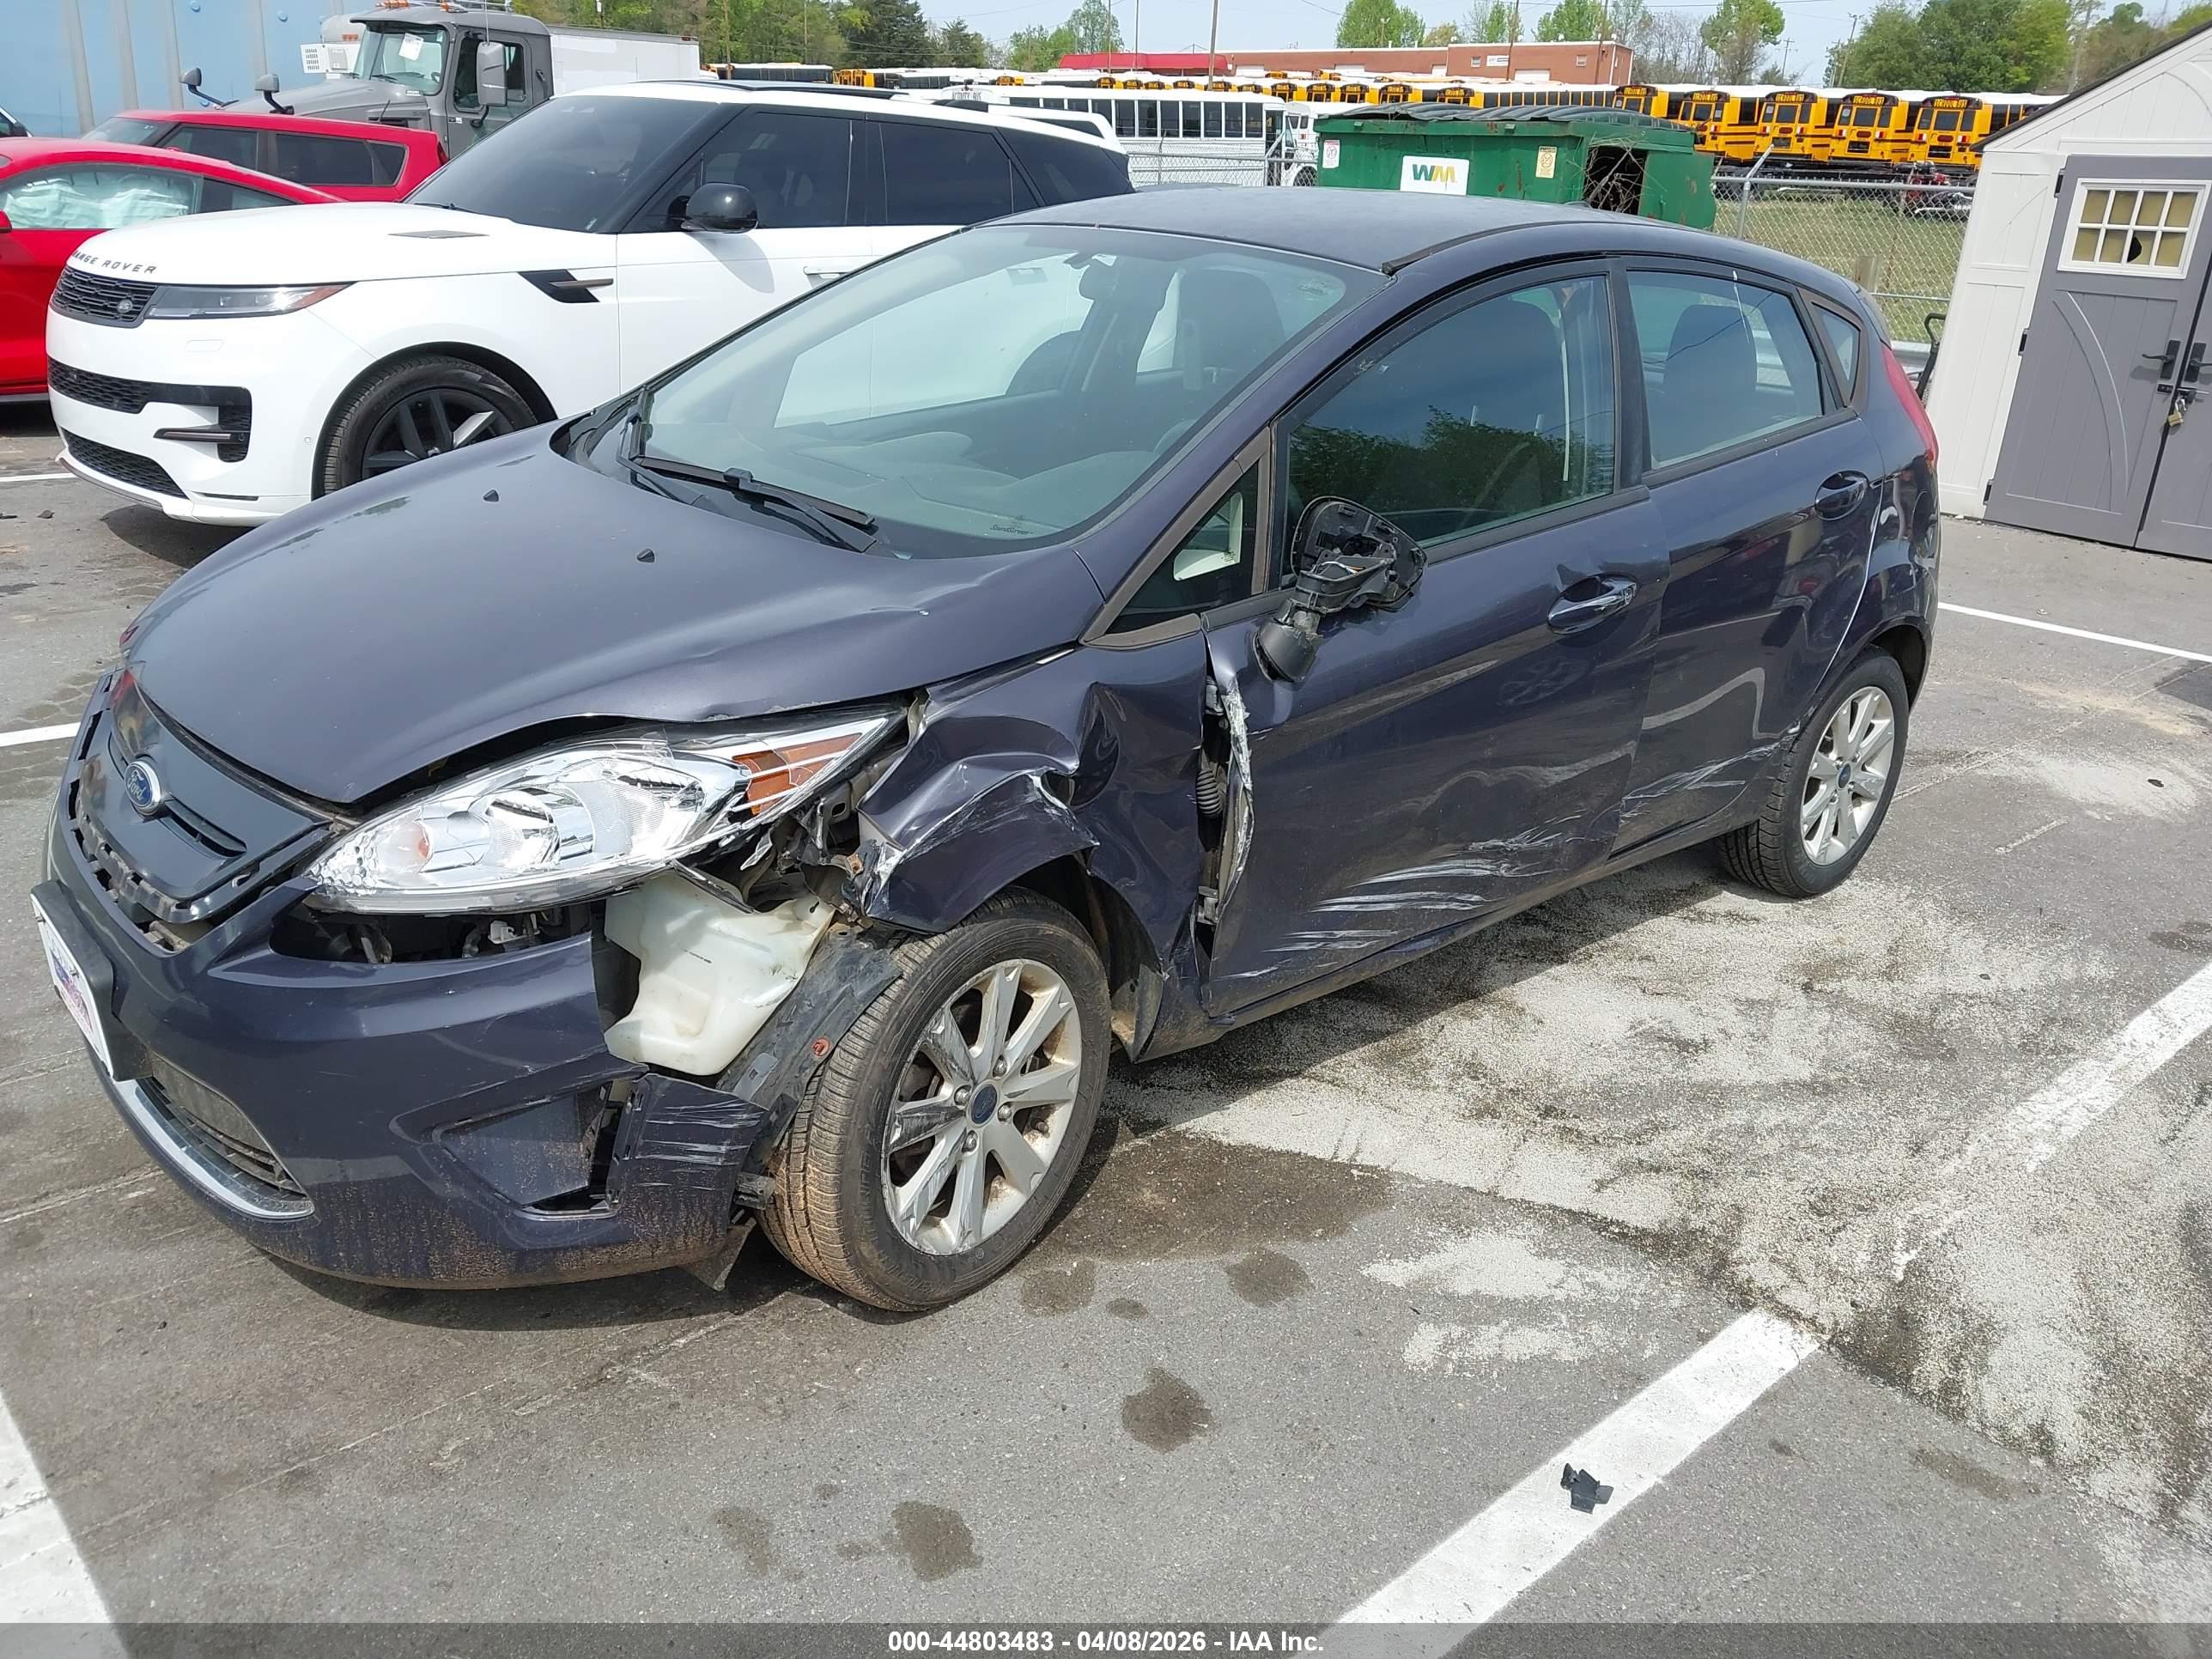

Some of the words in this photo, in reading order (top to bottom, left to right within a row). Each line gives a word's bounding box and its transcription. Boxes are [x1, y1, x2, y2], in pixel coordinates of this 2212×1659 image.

[1412, 164, 1457, 183] WM
[101, 259, 156, 274] ROVER
[127, 769, 147, 801] Ford
